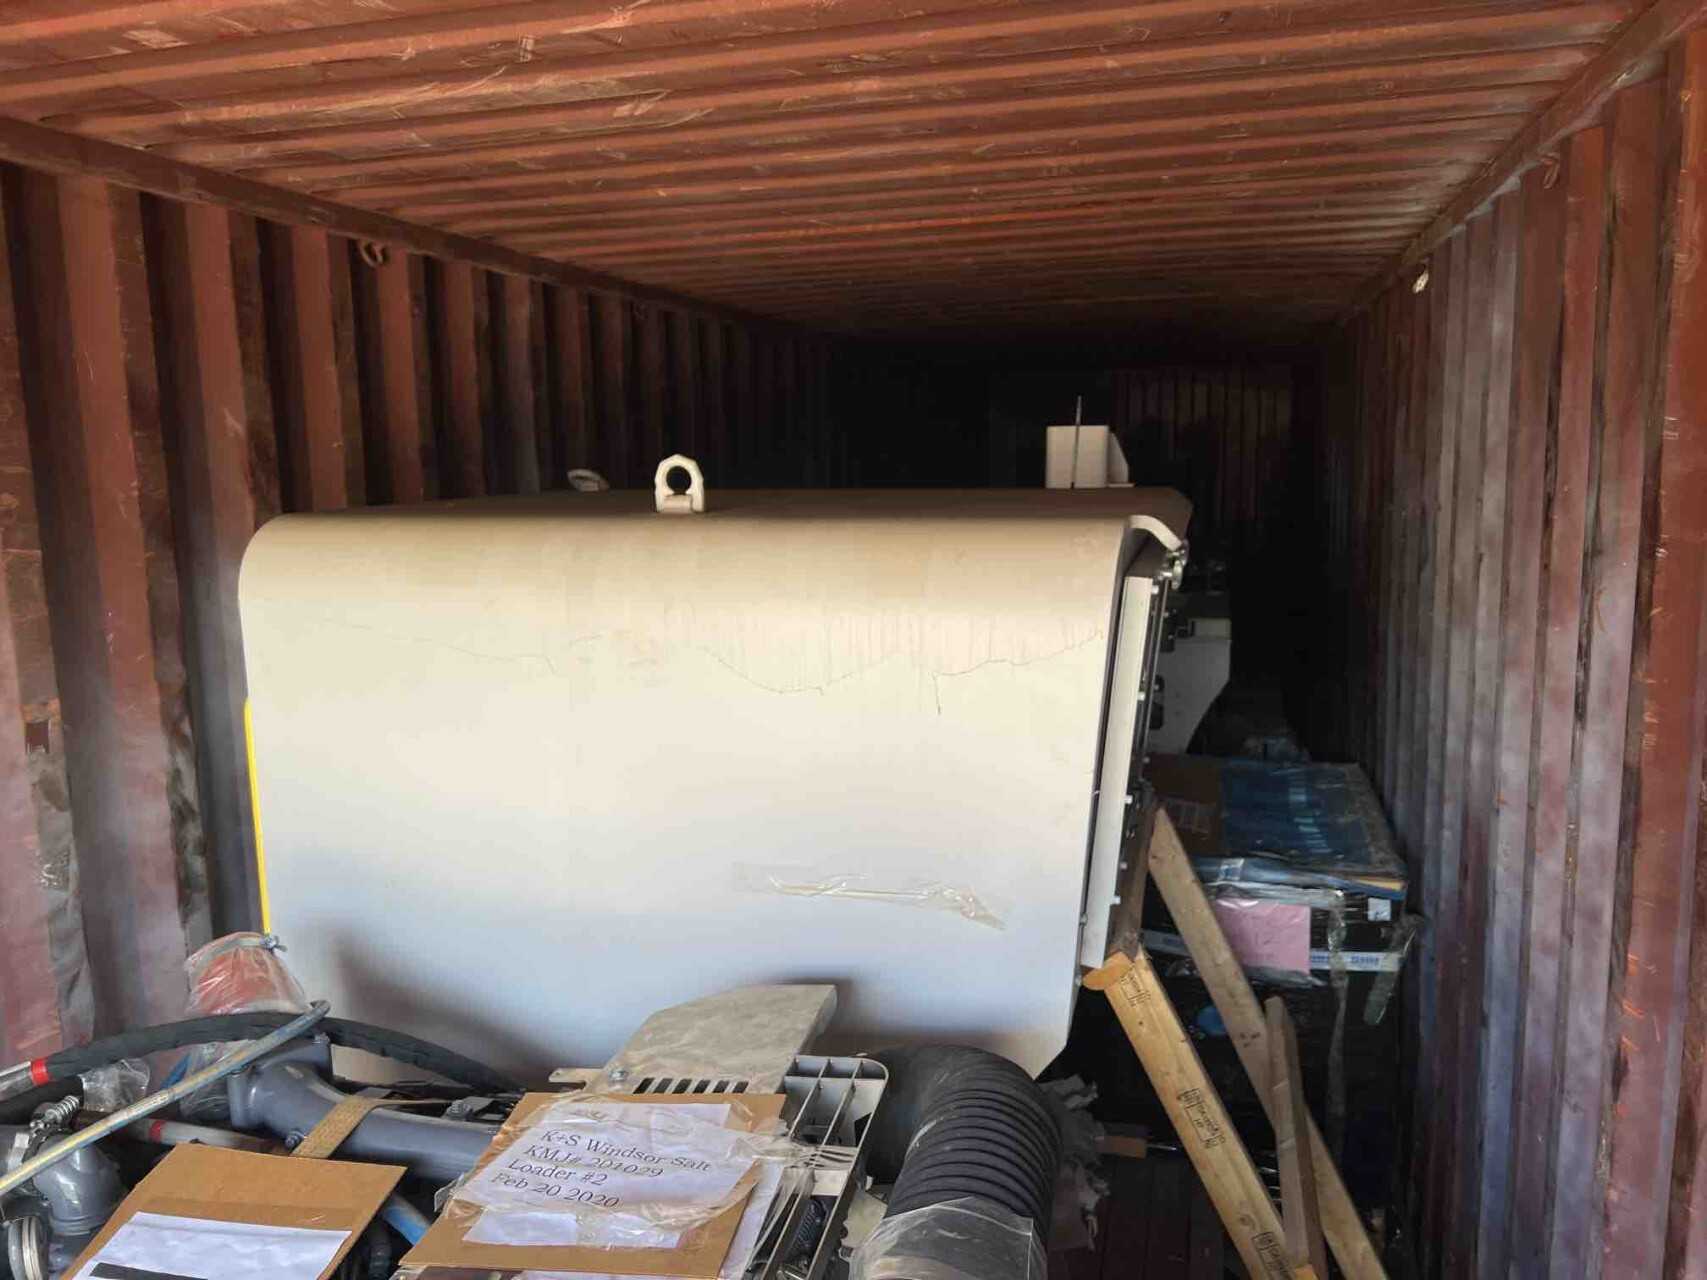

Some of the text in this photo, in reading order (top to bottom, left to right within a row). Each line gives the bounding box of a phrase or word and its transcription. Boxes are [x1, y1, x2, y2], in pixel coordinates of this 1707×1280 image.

[541, 1130, 711, 1172] K+S Windsor Salt
[507, 1158, 608, 1186] Loader #2
[584, 1157, 664, 1178] 201029
[491, 1173, 619, 1208] Feb 20 2020
